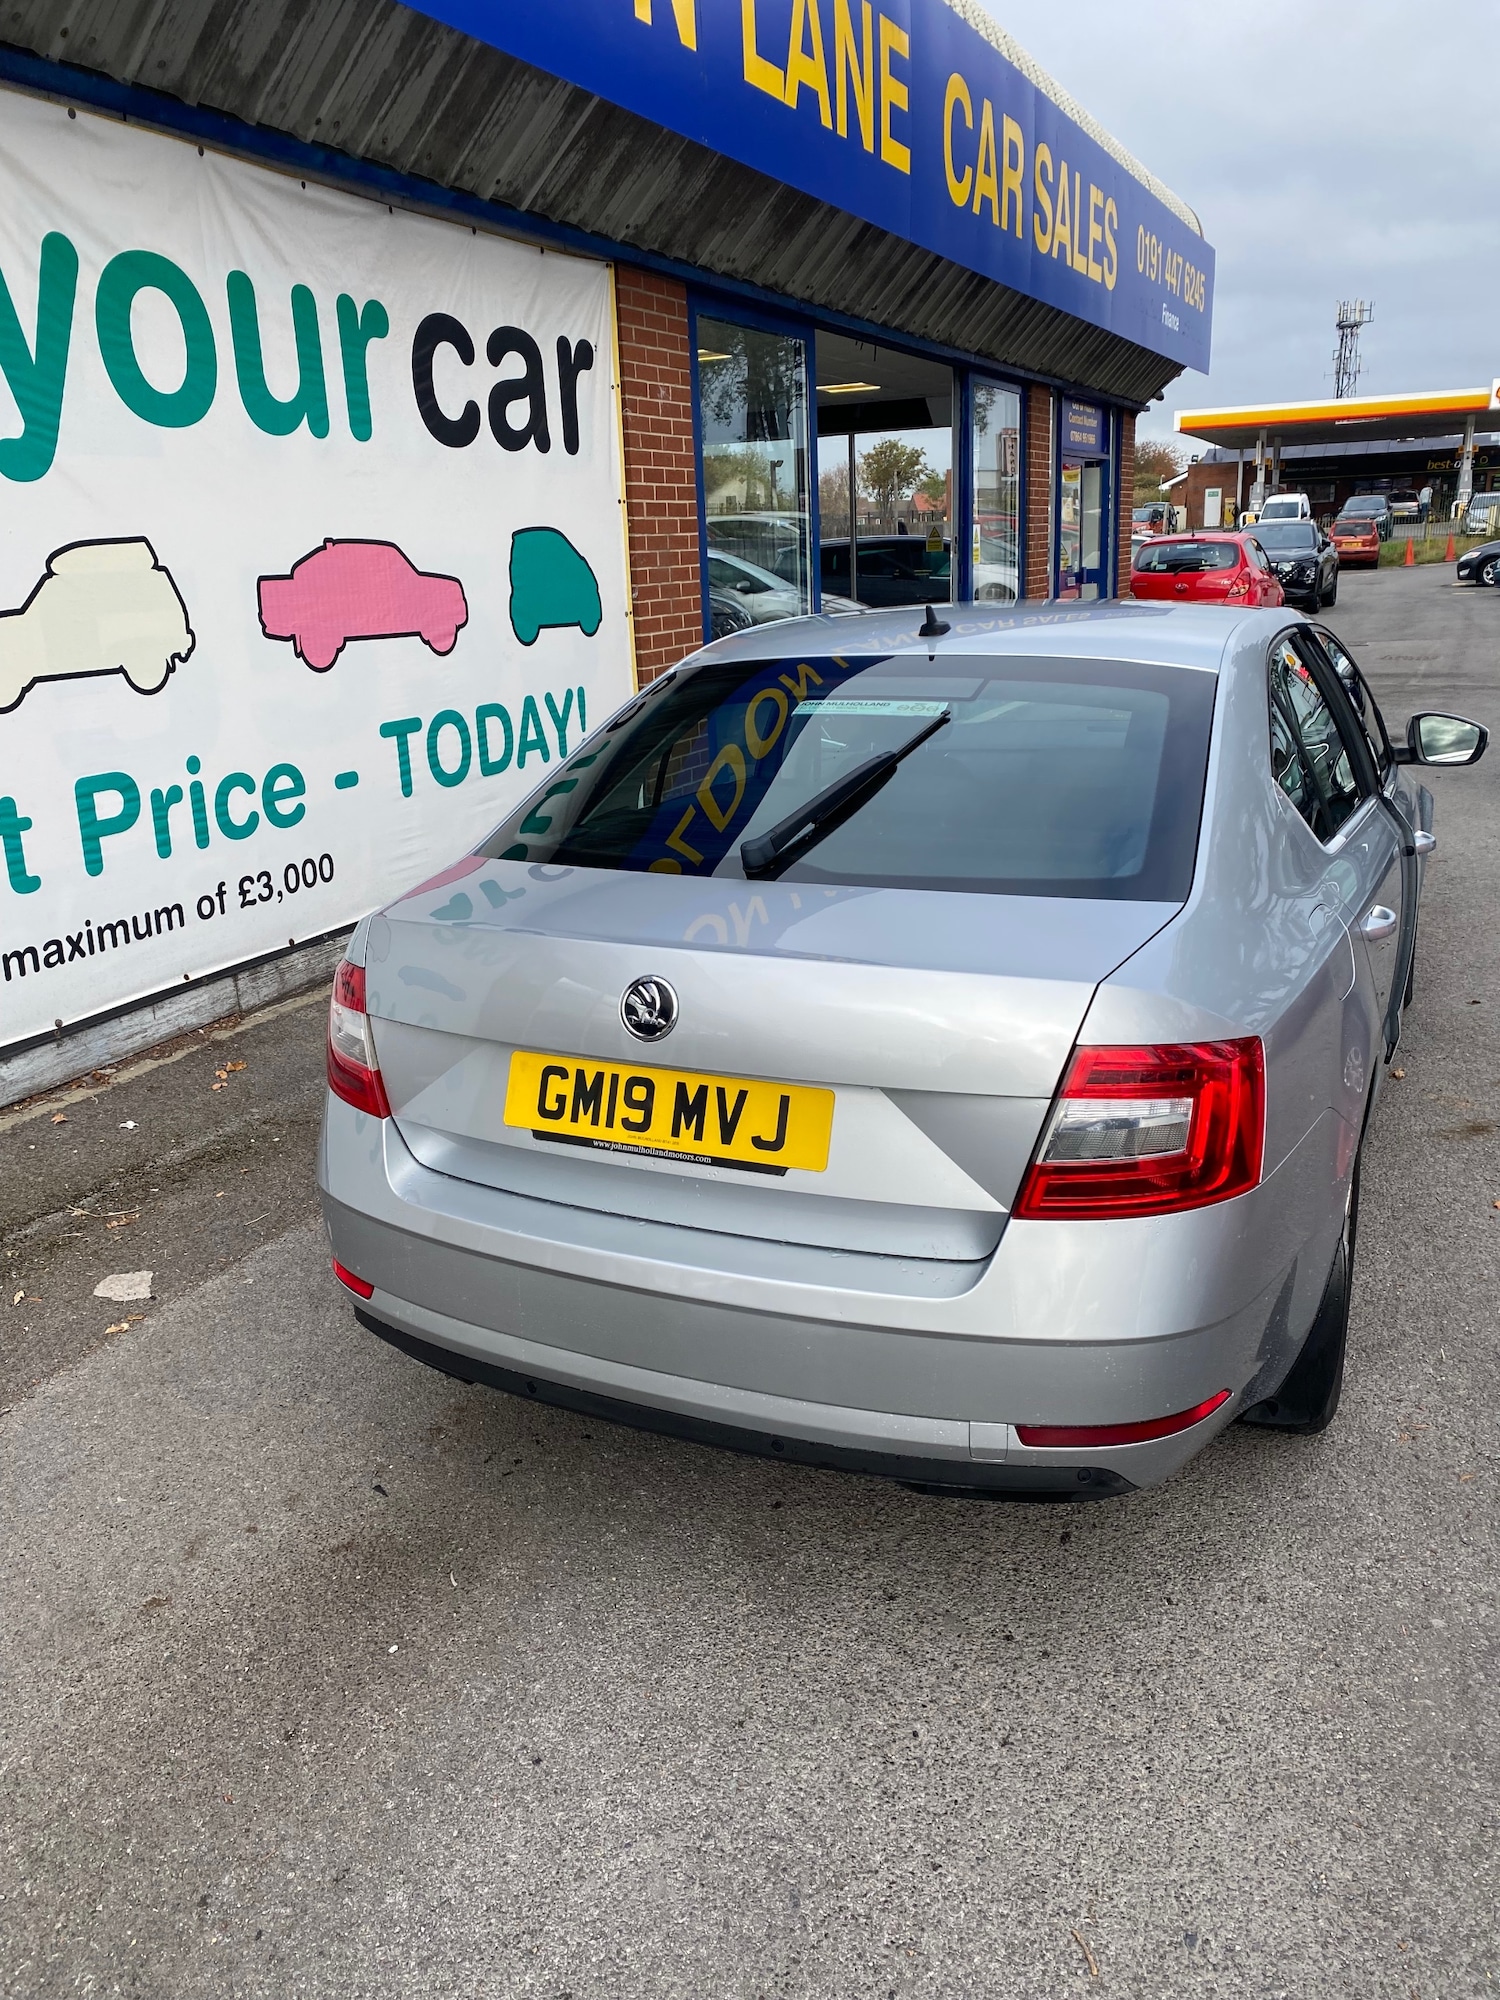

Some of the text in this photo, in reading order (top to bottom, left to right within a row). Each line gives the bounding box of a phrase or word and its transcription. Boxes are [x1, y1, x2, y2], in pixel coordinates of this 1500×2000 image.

[741, 0, 1118, 291] LANE CAR SALES
[1137, 224, 1205, 312] 0191 447 6245
[1162, 303, 1180, 331] Finance
[0, 231, 594, 482] your car
[75, 755, 306, 877] Price
[380, 686, 587, 798] TODAY!
[2, 852, 334, 981] maximum of £3,000
[537, 1065, 790, 1152] GM19 MVJ
[593, 1140, 711, 1163] www.johnmulhollandmotors.com
